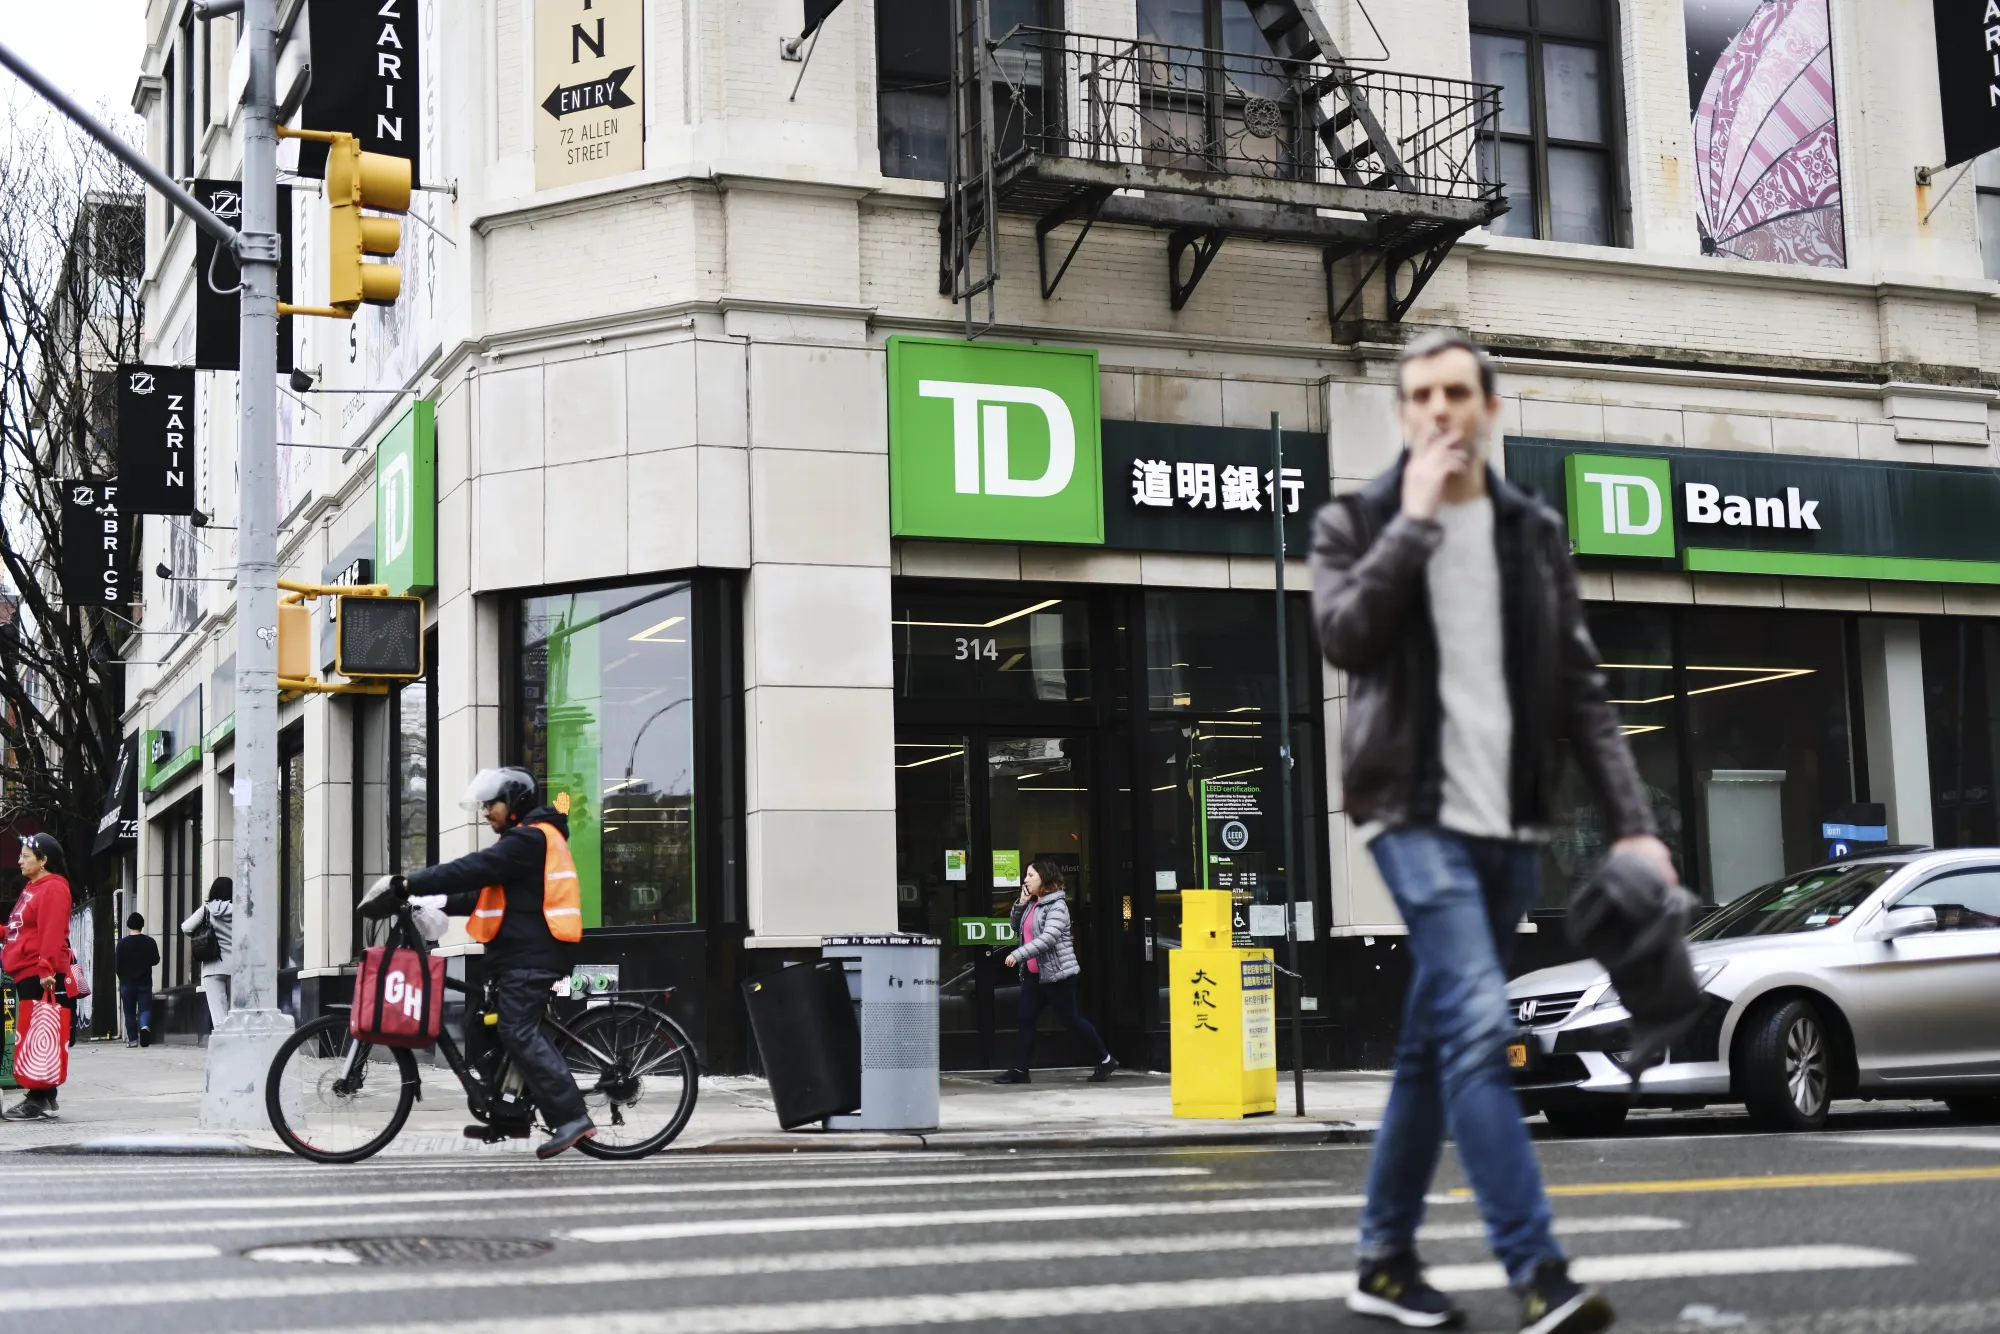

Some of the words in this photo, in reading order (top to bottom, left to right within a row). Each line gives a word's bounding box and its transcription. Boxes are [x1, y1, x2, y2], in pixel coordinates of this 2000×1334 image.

[571, 0, 606, 64] N
[377, 0, 403, 141] ZARIN
[561, 81, 615, 112] ENTRY
[560, 128, 574, 146] 72
[581, 118, 618, 141] ALLEN
[567, 141, 611, 165] STREET
[166, 394, 184, 487] ZARIN
[918, 379, 1076, 498] TD
[380, 452, 409, 566] TD
[1131, 458, 1305, 514] 道明銀行
[1584, 472, 1662, 535] TD
[1684, 482, 1822, 531] Bank
[103, 486, 119, 601] FABRICS
[955, 637, 999, 661] 314
[120, 820, 138, 831] 72
[1228, 831, 1243, 840] LEED
[863, 936, 887, 945] Don't
[890, 937, 910, 945] litter
[962, 922, 986, 940] TD
[385, 970, 422, 1021] GH
[913, 978, 924, 986] Put
[1191, 969, 1218, 1032] 大紀元
